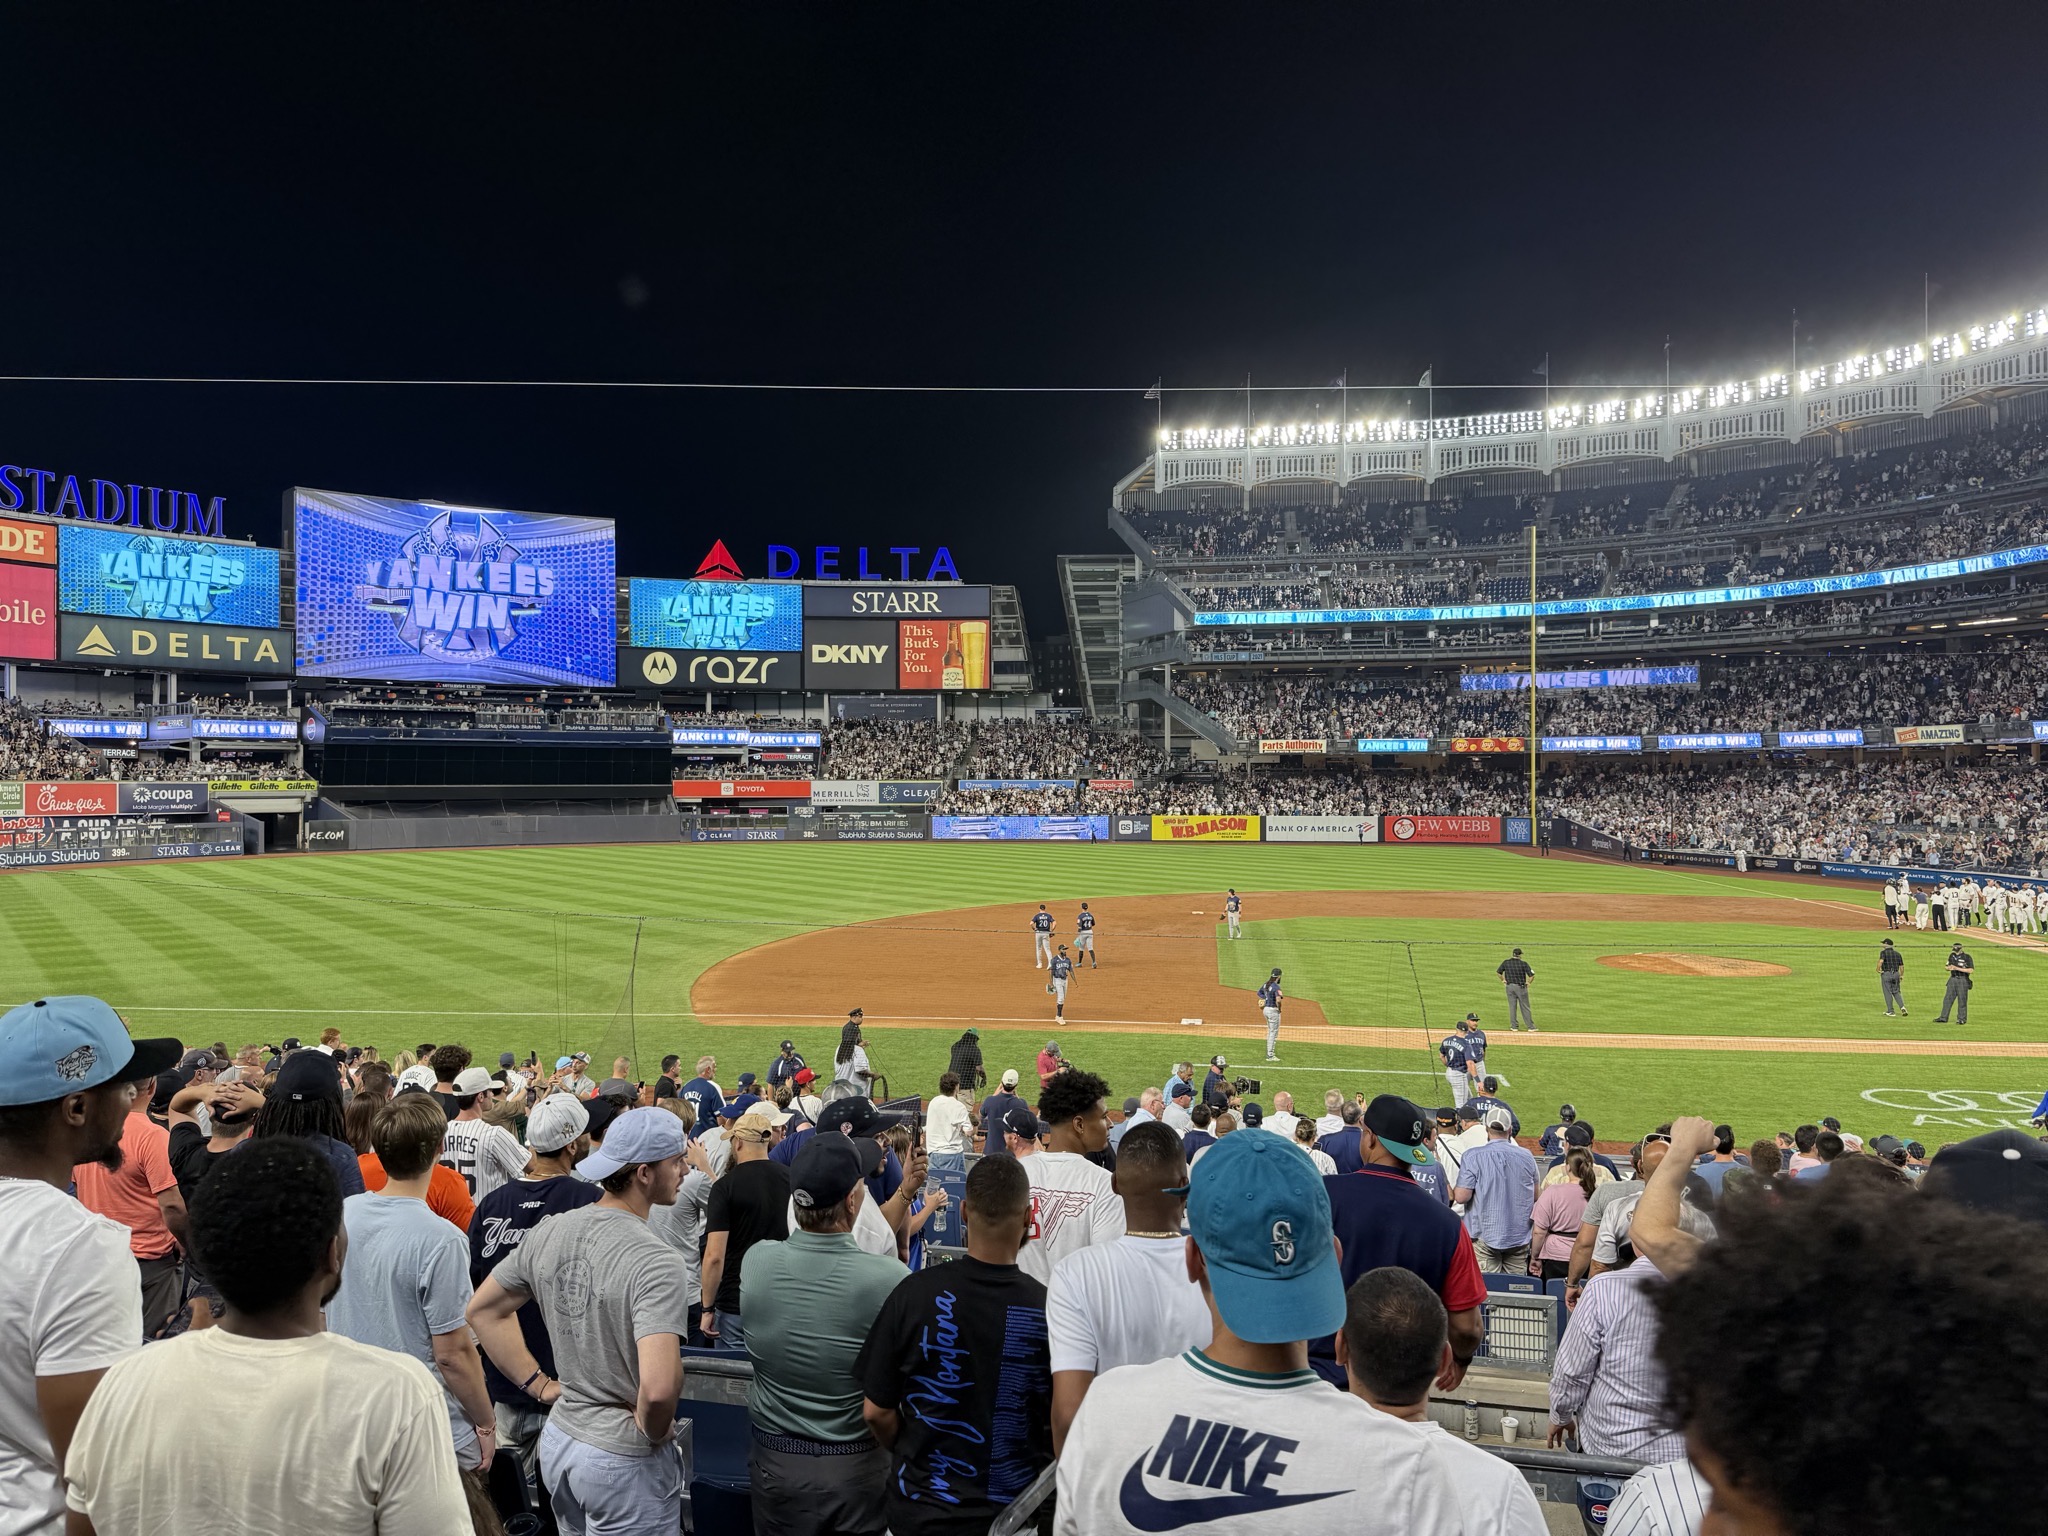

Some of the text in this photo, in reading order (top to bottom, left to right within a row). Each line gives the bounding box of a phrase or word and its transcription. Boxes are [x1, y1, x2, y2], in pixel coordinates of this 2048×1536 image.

[0, 465, 227, 538] STADIUM
[101, 551, 245, 585] YANKEES
[768, 545, 961, 581] DELTA
[365, 553, 555, 597] YANKEES
[1884, 556, 1993, 585] YANKEES WIN
[138, 579, 210, 606] WIN
[1652, 587, 1760, 609] YANKEES WIN
[661, 593, 775, 619] YANKEES
[852, 591, 942, 613] STARR
[413, 587, 510, 631] WIN
[1432, 606, 1501, 619] YANKEES
[691, 615, 747, 637] WIN
[904, 625, 933, 636] This
[132, 630, 280, 663] DELTA
[904, 638, 939, 649] Bud's
[812, 644, 889, 664] DKNY
[904, 650, 926, 661] For
[689, 656, 778, 684] razr
[904, 662, 932, 673] You.
[1509, 670, 1649, 689] YANKEES WIN
[116, 724, 142, 735] WIN
[201, 723, 297, 735] YANKEES WIN
[1921, 728, 1961, 740] AMAZING
[673, 732, 749, 741] YANKEES WIN
[797, 735, 817, 744] WIN
[1674, 735, 1747, 746] YANKEES WIN
[1786, 732, 1857, 743] YANKEES WIN
[1263, 742, 1284, 750] Parts
[1555, 740, 1629, 748] YANKEES WIN
[103, 749, 136, 757] TERRACE
[211, 782, 315, 791] Gillette Gillette Gillette
[152, 789, 193, 803] coupa
[904, 789, 937, 797] CLEAR
[1417, 819, 1442, 831] F.W.
[1446, 820, 1491, 832] WEBB
[1540, 820, 1552, 828] 314
[747, 831, 778, 839] STARR
[112, 848, 126, 857] 399
[157, 845, 189, 856] STARR
[0, 850, 100, 865] StubHub StubHub
[1448, 1049, 1454, 1061] 9
[523, 1201, 541, 1209] PRO
[1146, 1413, 1300, 1496] NIKE
[1592, 1509, 1608, 1517] PEPS
